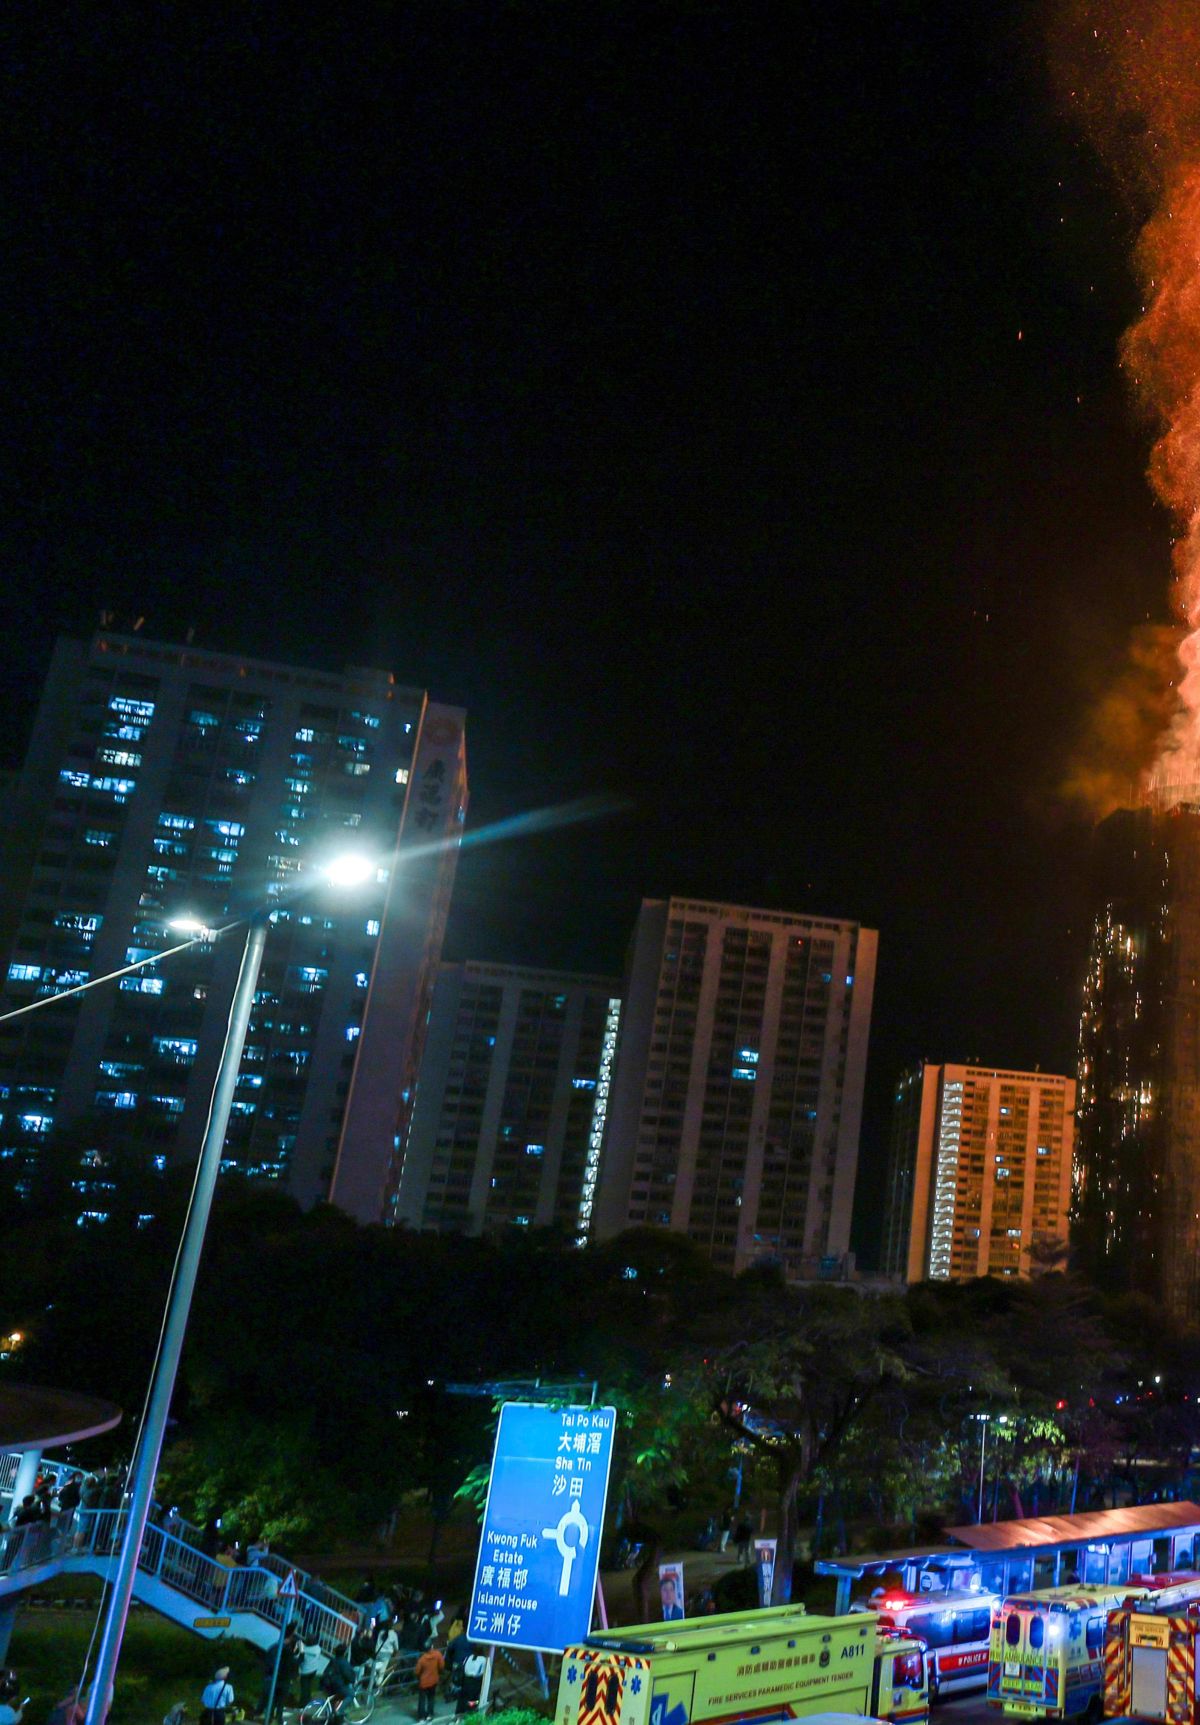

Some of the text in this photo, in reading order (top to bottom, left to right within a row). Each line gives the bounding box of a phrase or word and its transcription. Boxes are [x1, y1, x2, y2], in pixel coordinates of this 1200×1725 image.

[562, 1413, 610, 1428] Tai Po Kau
[558, 1431, 602, 1454] 大埔滘
[555, 1456, 592, 1472] Sha Tin
[552, 1474, 583, 1498] 沙田
[487, 1530, 538, 1549] Kwong Fuk
[493, 1549, 523, 1565] Estate
[480, 1565, 528, 1591] 廣福邨
[477, 1591, 538, 1611] Island House
[473, 1610, 521, 1636] 元洲仔
[840, 1644, 865, 1659] A811
[963, 1653, 981, 1664] POLICE
[1004, 1650, 1043, 1667] AMBULANCE
[708, 1669, 854, 1706] FIRE SERVICES PARAMEDIC EQUIPMENT TENDER
